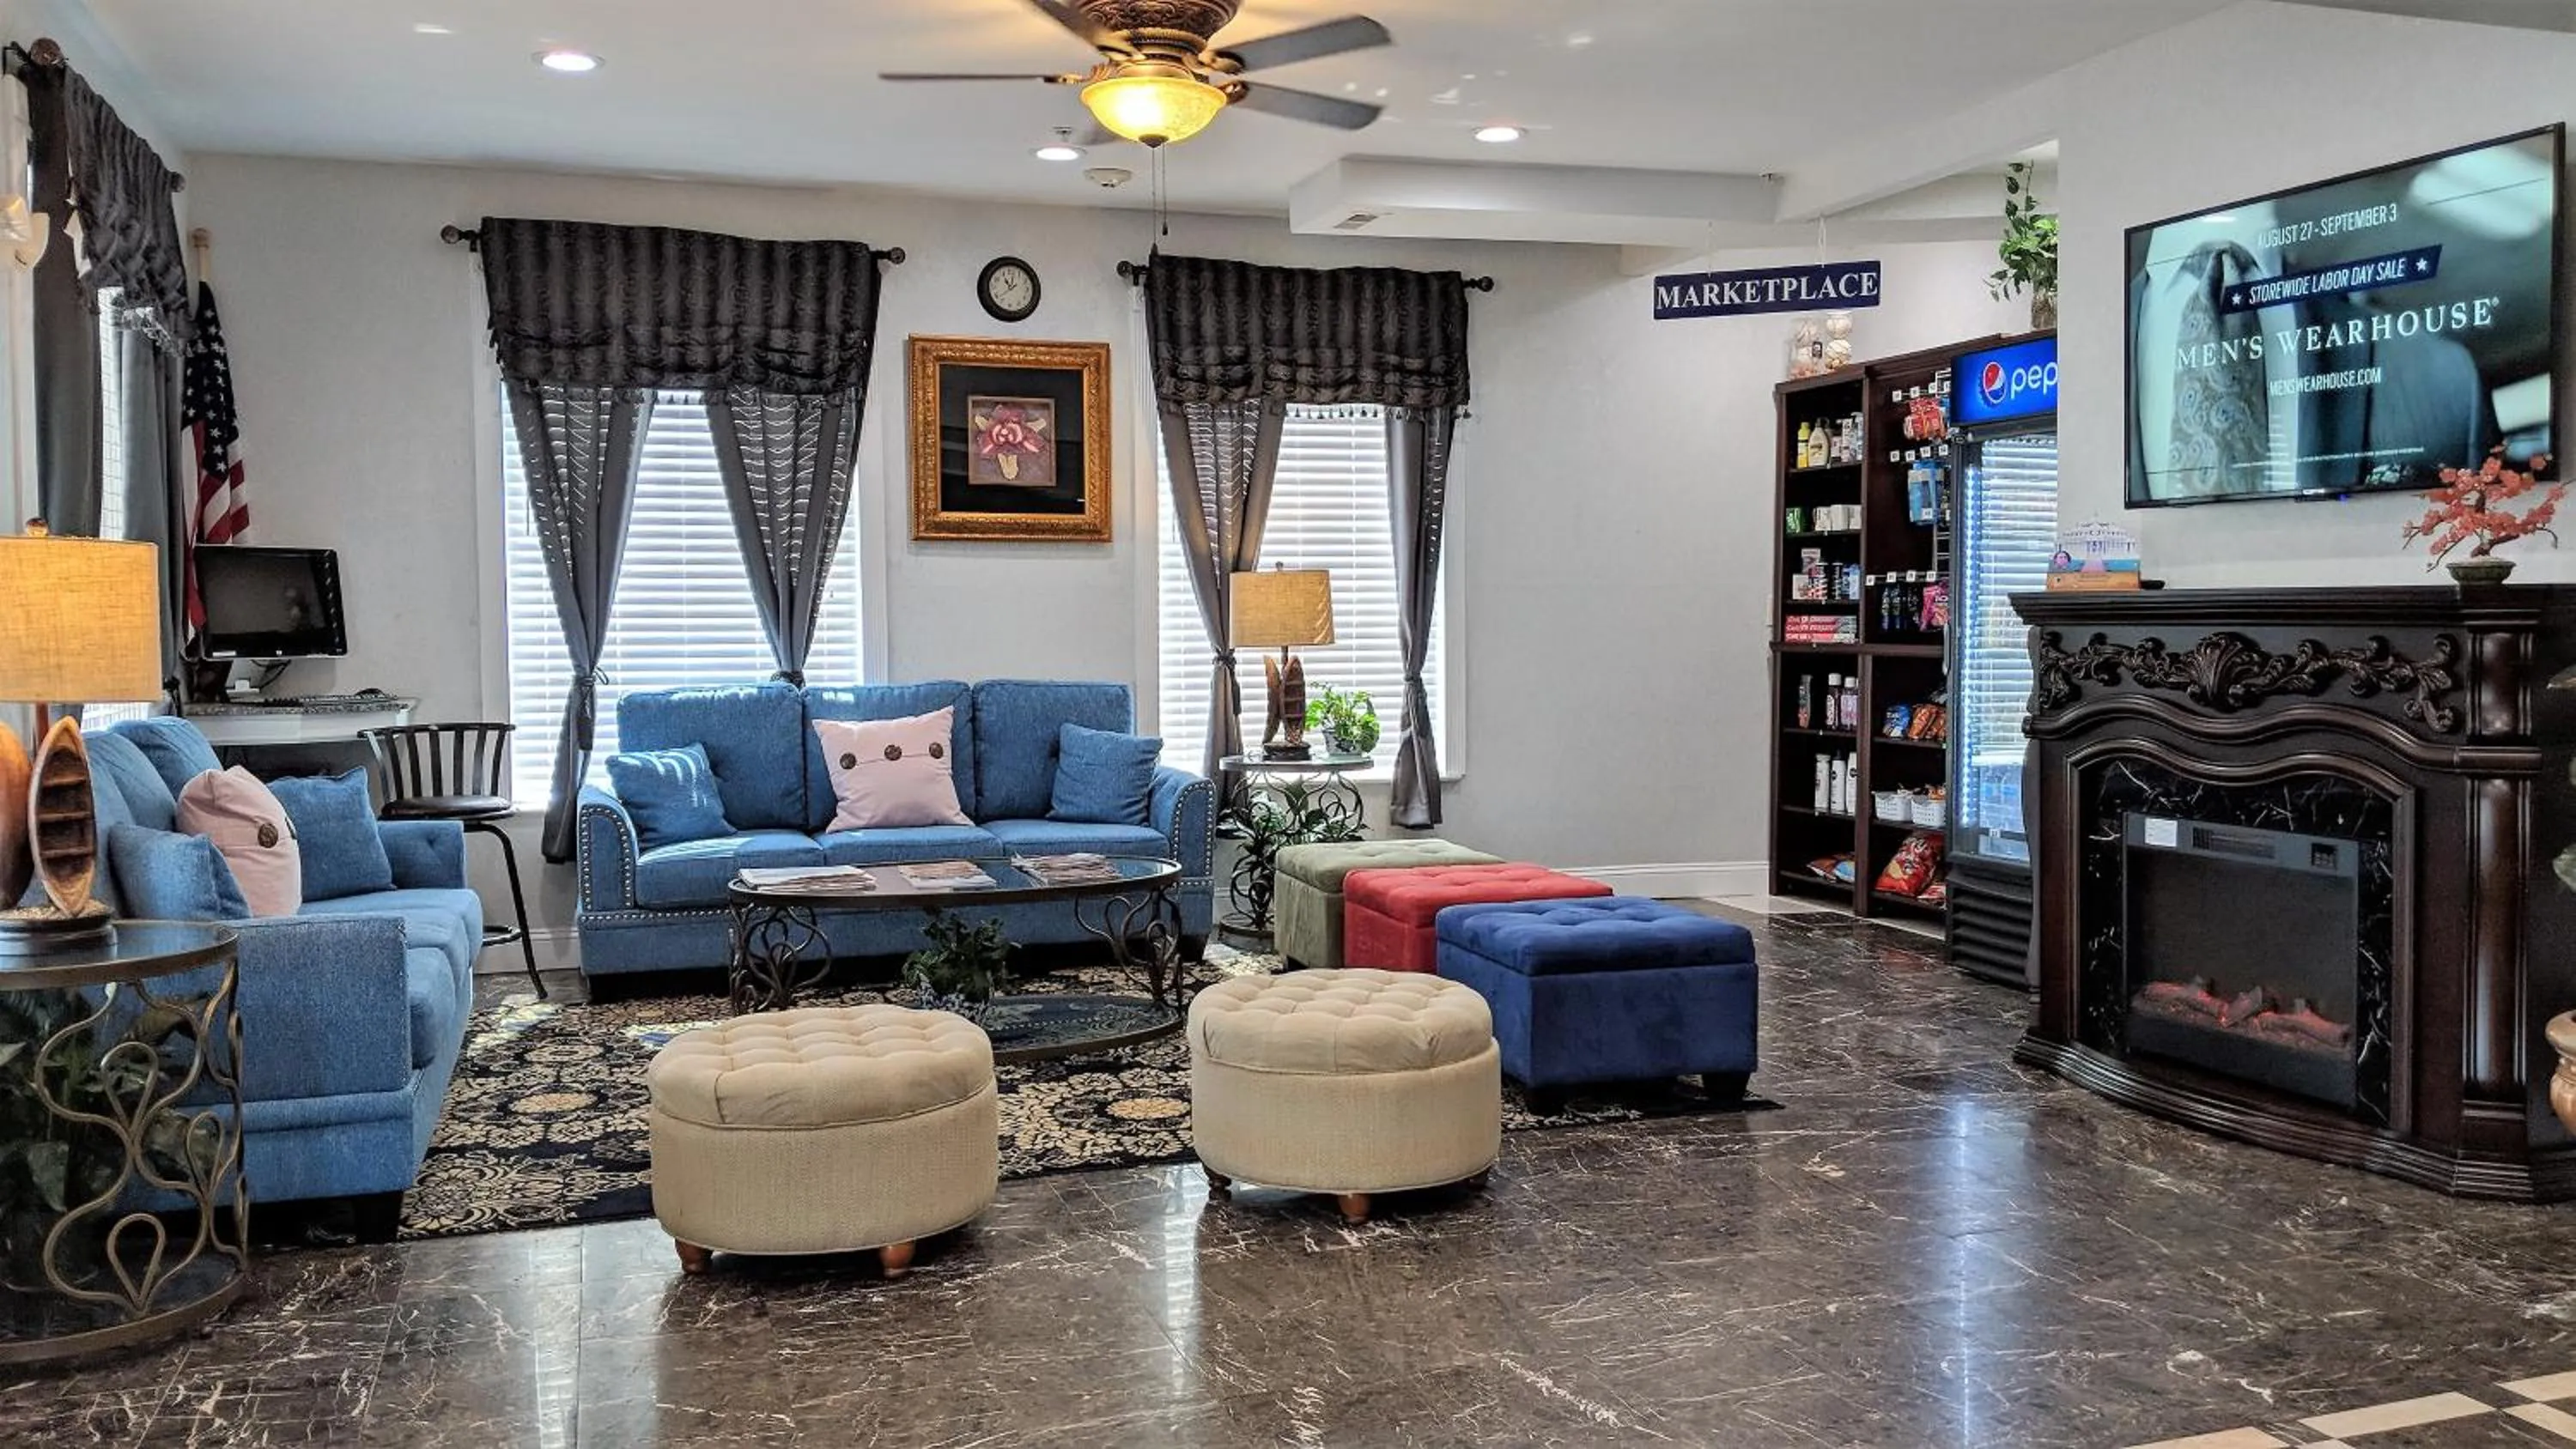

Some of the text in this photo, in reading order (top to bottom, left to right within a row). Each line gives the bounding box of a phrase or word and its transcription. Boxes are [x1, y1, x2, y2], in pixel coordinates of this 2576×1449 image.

[2257, 224, 2299, 249] AUGUST
[2300, 221, 2312, 241] 27
[2321, 206, 2386, 237] SEPTEMBER
[2388, 203, 2397, 222] 3
[1656, 272, 1878, 310] MARKETPLACE
[2249, 258, 2407, 304] STOREWIDE LABOR DAY SALE
[2175, 336, 2263, 369] MEN'S
[2010, 361, 2058, 400] pep
[2269, 367, 2382, 396] MENSWEARHOUSE.COM
